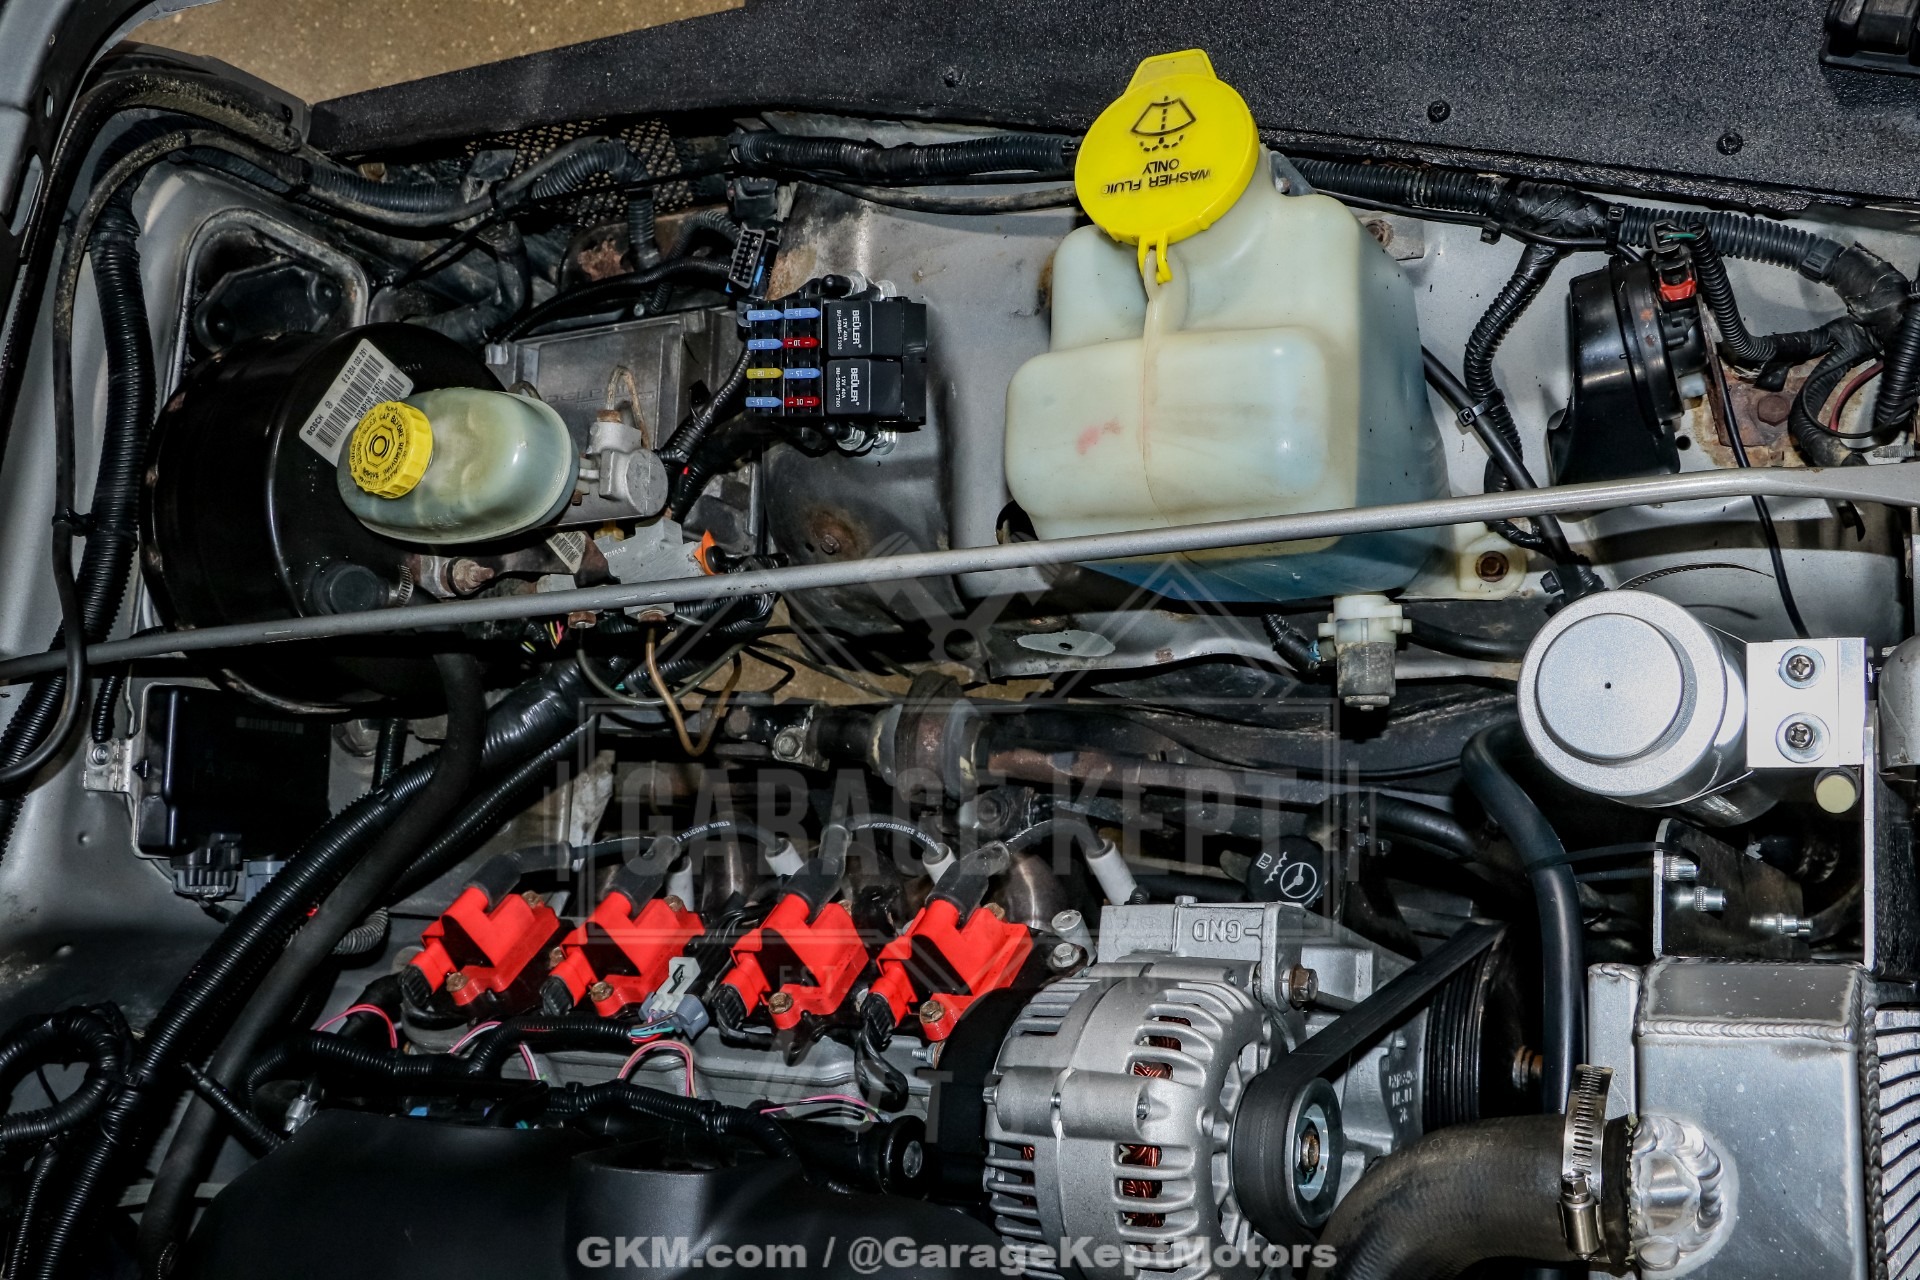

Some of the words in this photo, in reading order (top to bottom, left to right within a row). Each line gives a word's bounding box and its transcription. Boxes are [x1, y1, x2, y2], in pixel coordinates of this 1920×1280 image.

[1142, 158, 1180, 175] ONLY
[1148, 168, 1211, 188] WASHER
[306, 414, 324, 436] BOSCH
[390, 414, 404, 438] BEFORE
[682, 825, 708, 839] SILICONE
[709, 821, 731, 829] WIRES
[871, 822, 916, 835] PERFORMANCE
[1192, 918, 1242, 943] GND
